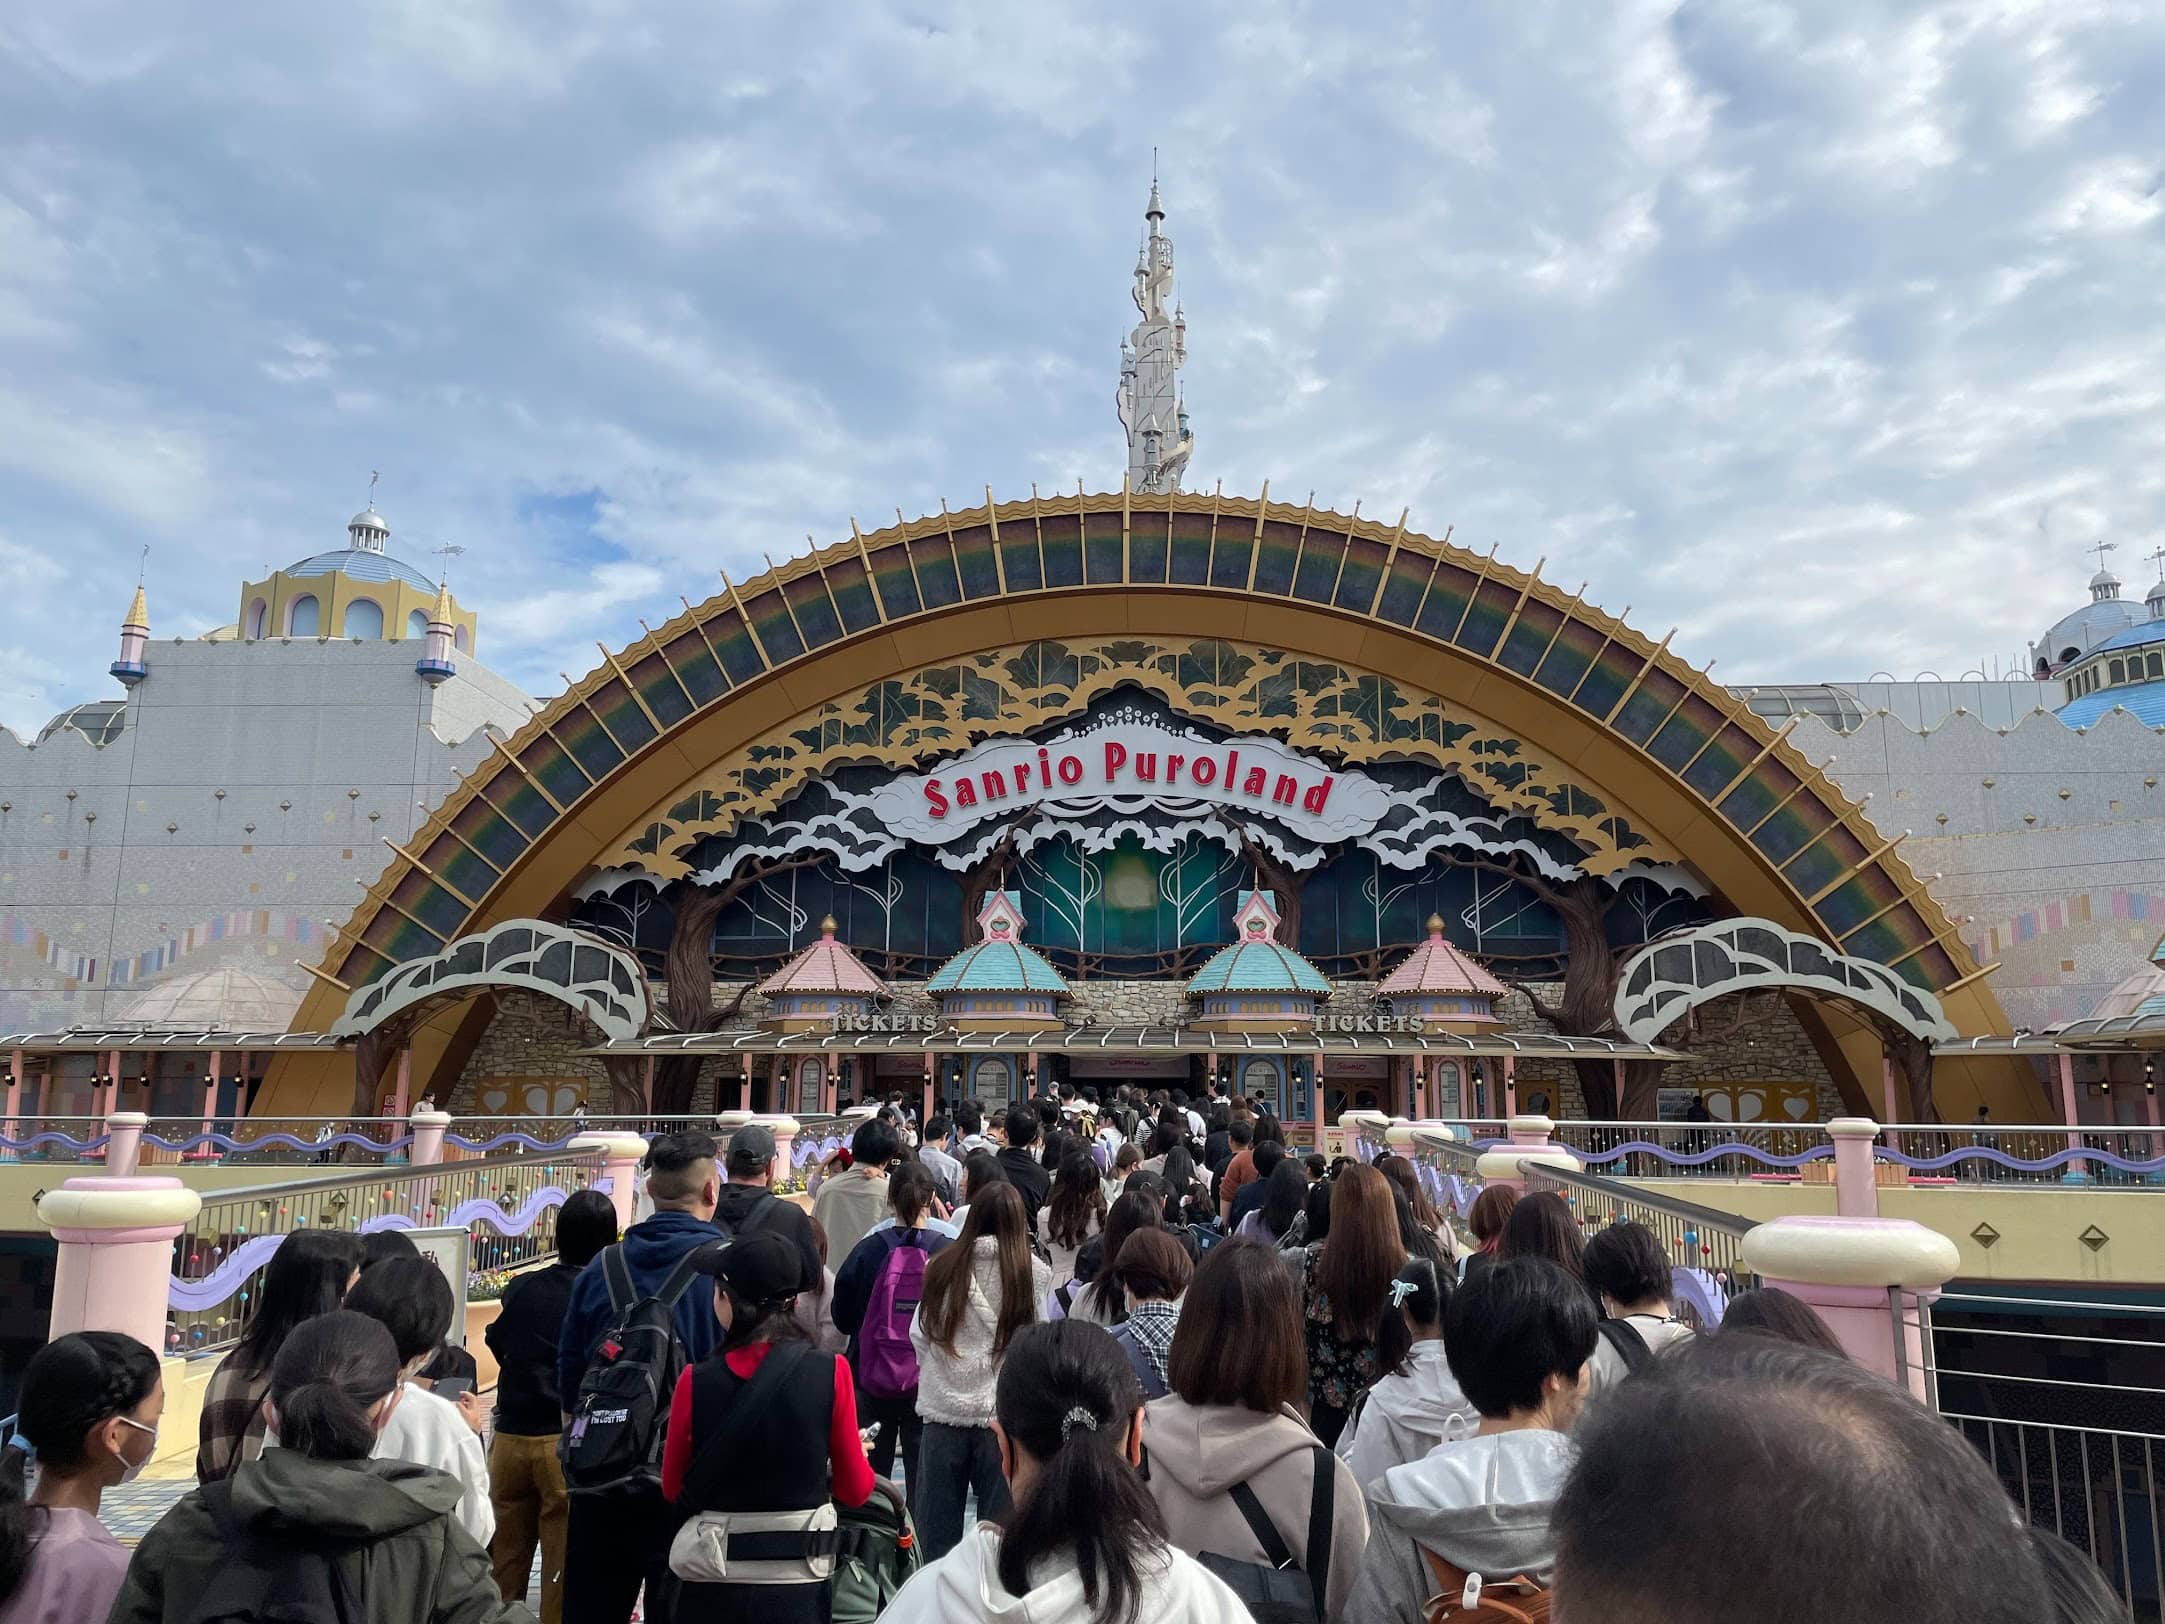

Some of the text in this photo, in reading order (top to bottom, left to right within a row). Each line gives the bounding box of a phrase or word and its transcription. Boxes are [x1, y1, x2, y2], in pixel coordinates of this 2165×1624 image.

[922, 742, 1334, 819] Sanrio Puroland
[833, 1014, 937, 1031] TICKETS
[1311, 1014, 1424, 1032] TICKETS
